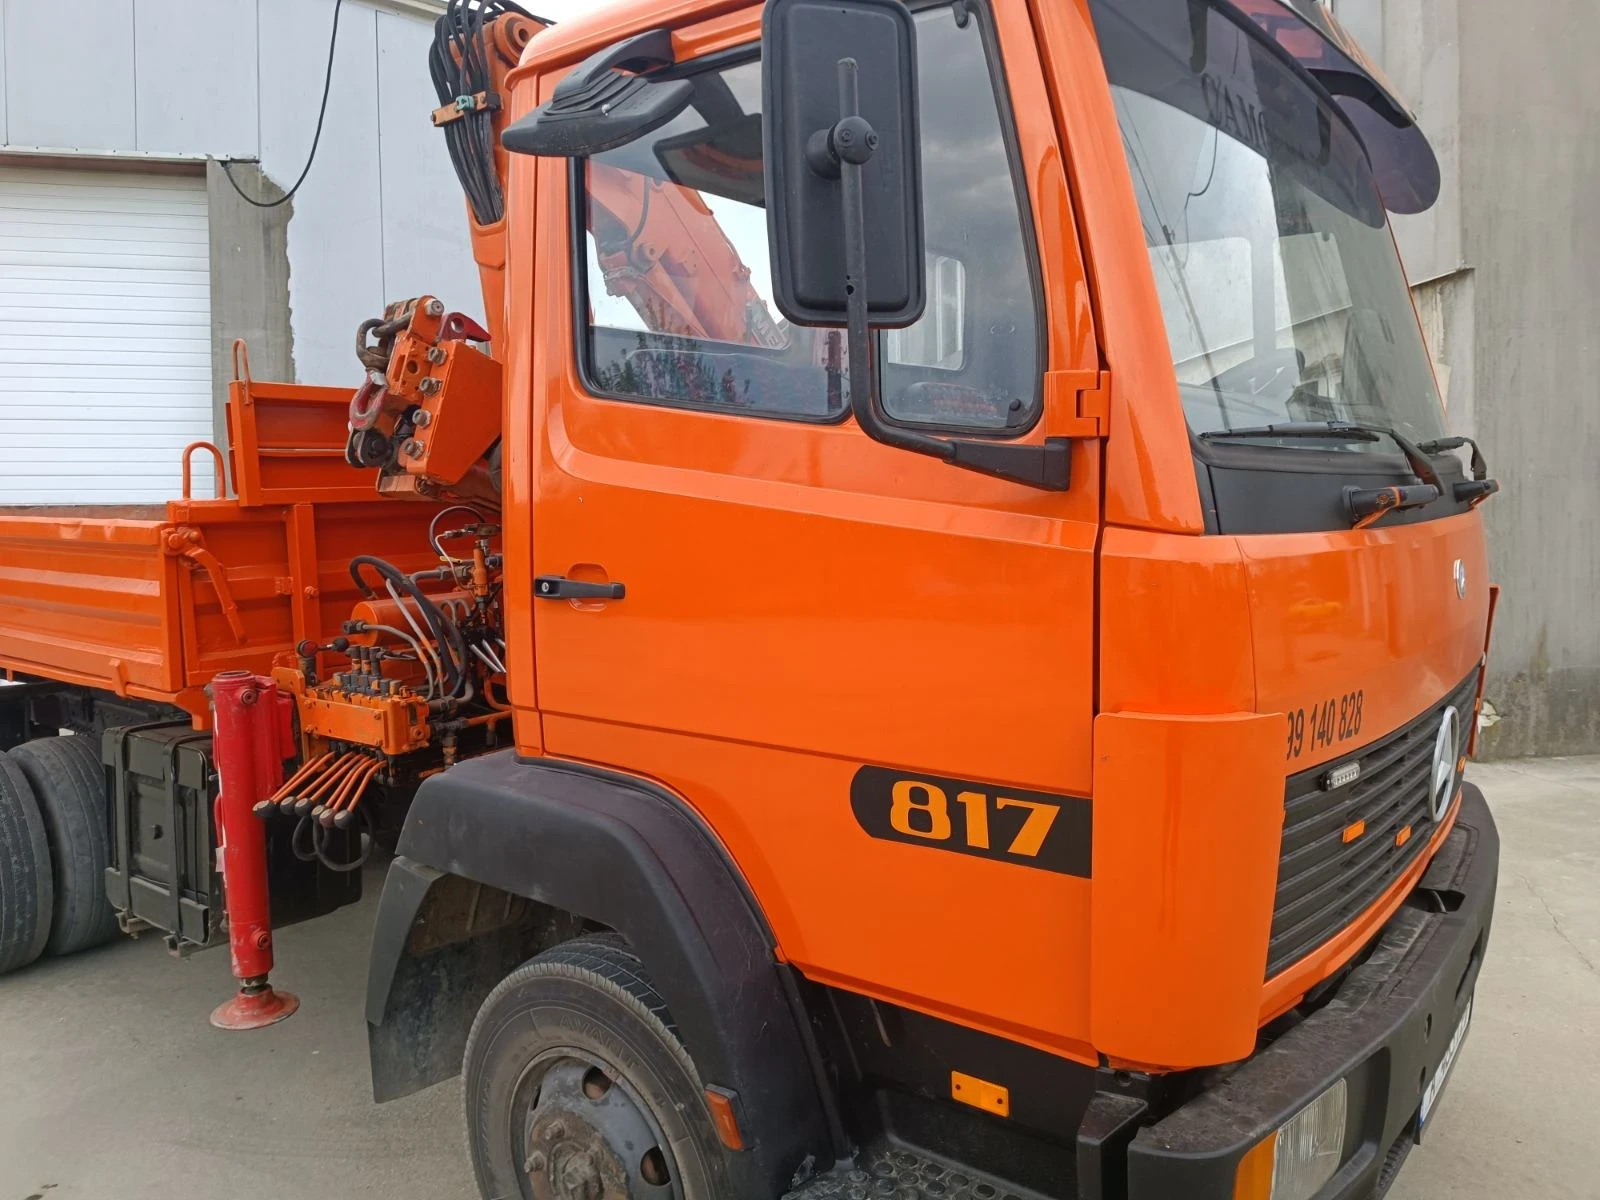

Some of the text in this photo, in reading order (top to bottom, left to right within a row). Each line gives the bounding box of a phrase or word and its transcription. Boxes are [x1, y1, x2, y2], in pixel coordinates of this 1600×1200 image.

[1310, 698, 1335, 752] 140
[1339, 689, 1363, 741] 828
[890, 780, 1061, 857] 817
